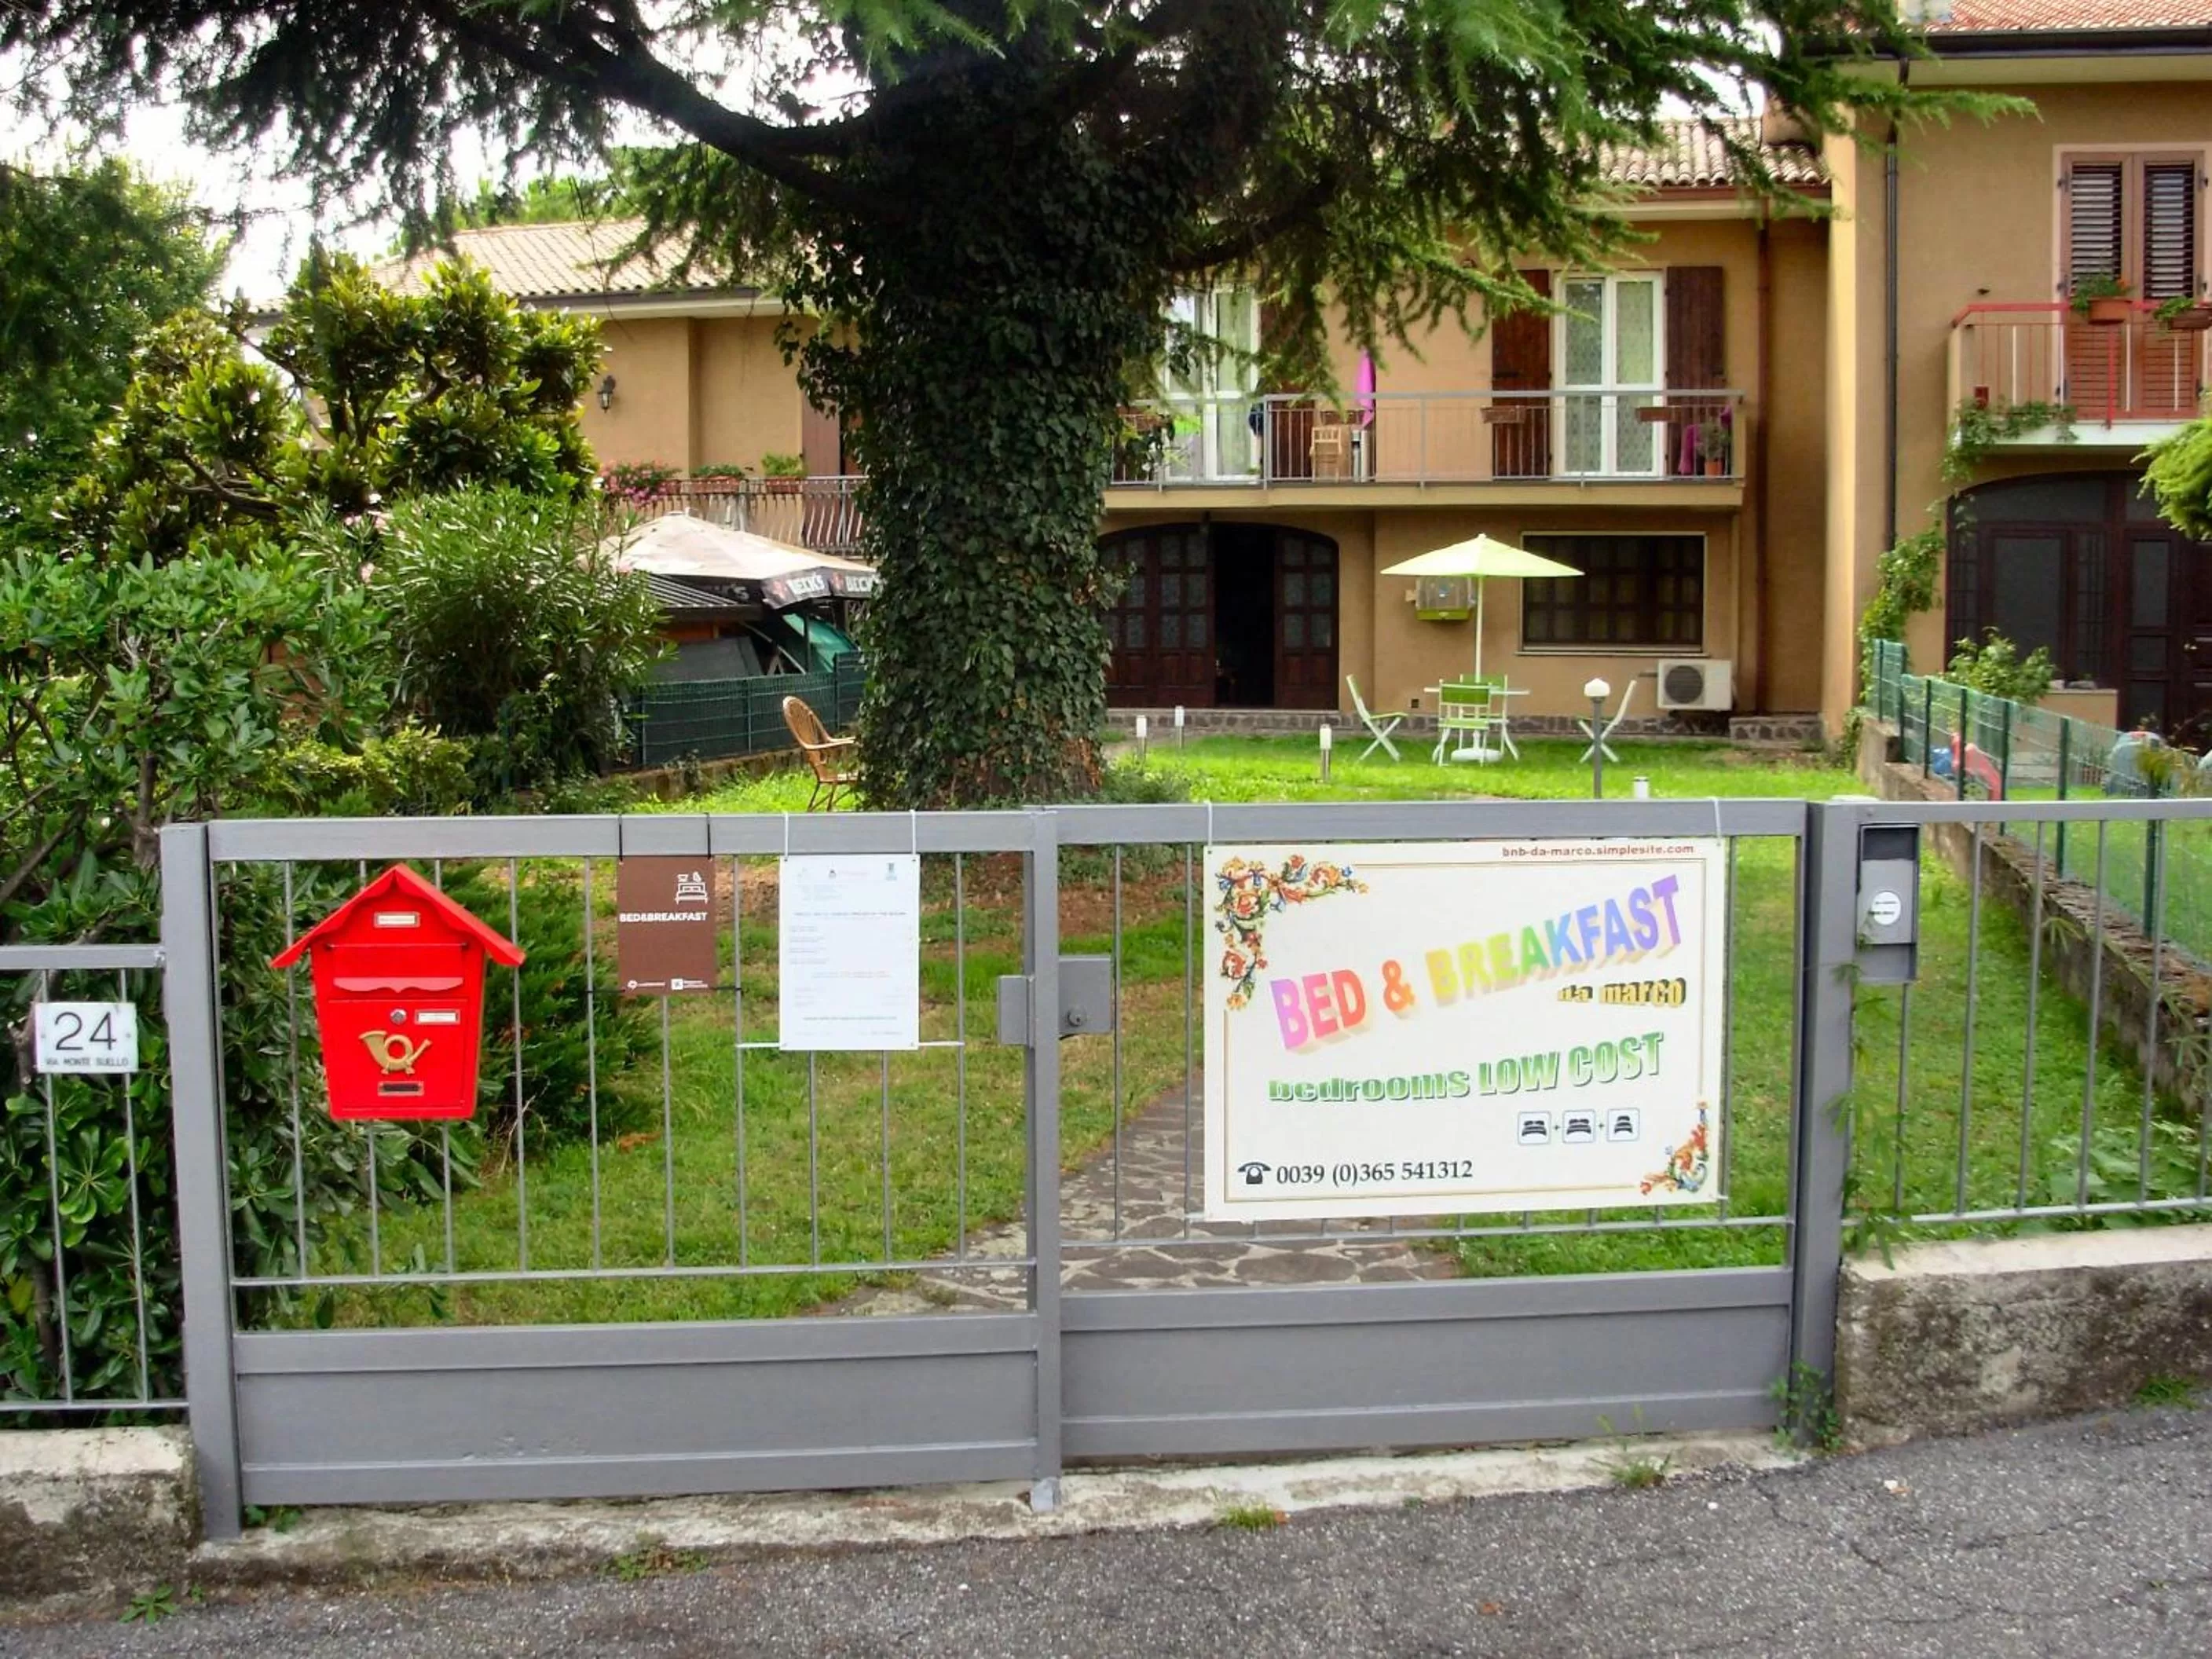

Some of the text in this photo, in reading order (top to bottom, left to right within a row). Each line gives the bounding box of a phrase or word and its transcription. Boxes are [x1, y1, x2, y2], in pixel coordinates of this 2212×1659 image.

[1502, 845, 1694, 857] bnb-da-marco.simplesite.com
[1270, 874, 1682, 1051] BED & BREAKFAST
[1599, 977, 1686, 1008] marco
[54, 1011, 117, 1051] 24
[1268, 1031, 1664, 1101] bedrooms LOW COST
[1276, 1160, 1474, 1187] 0039 (0)365 541312
